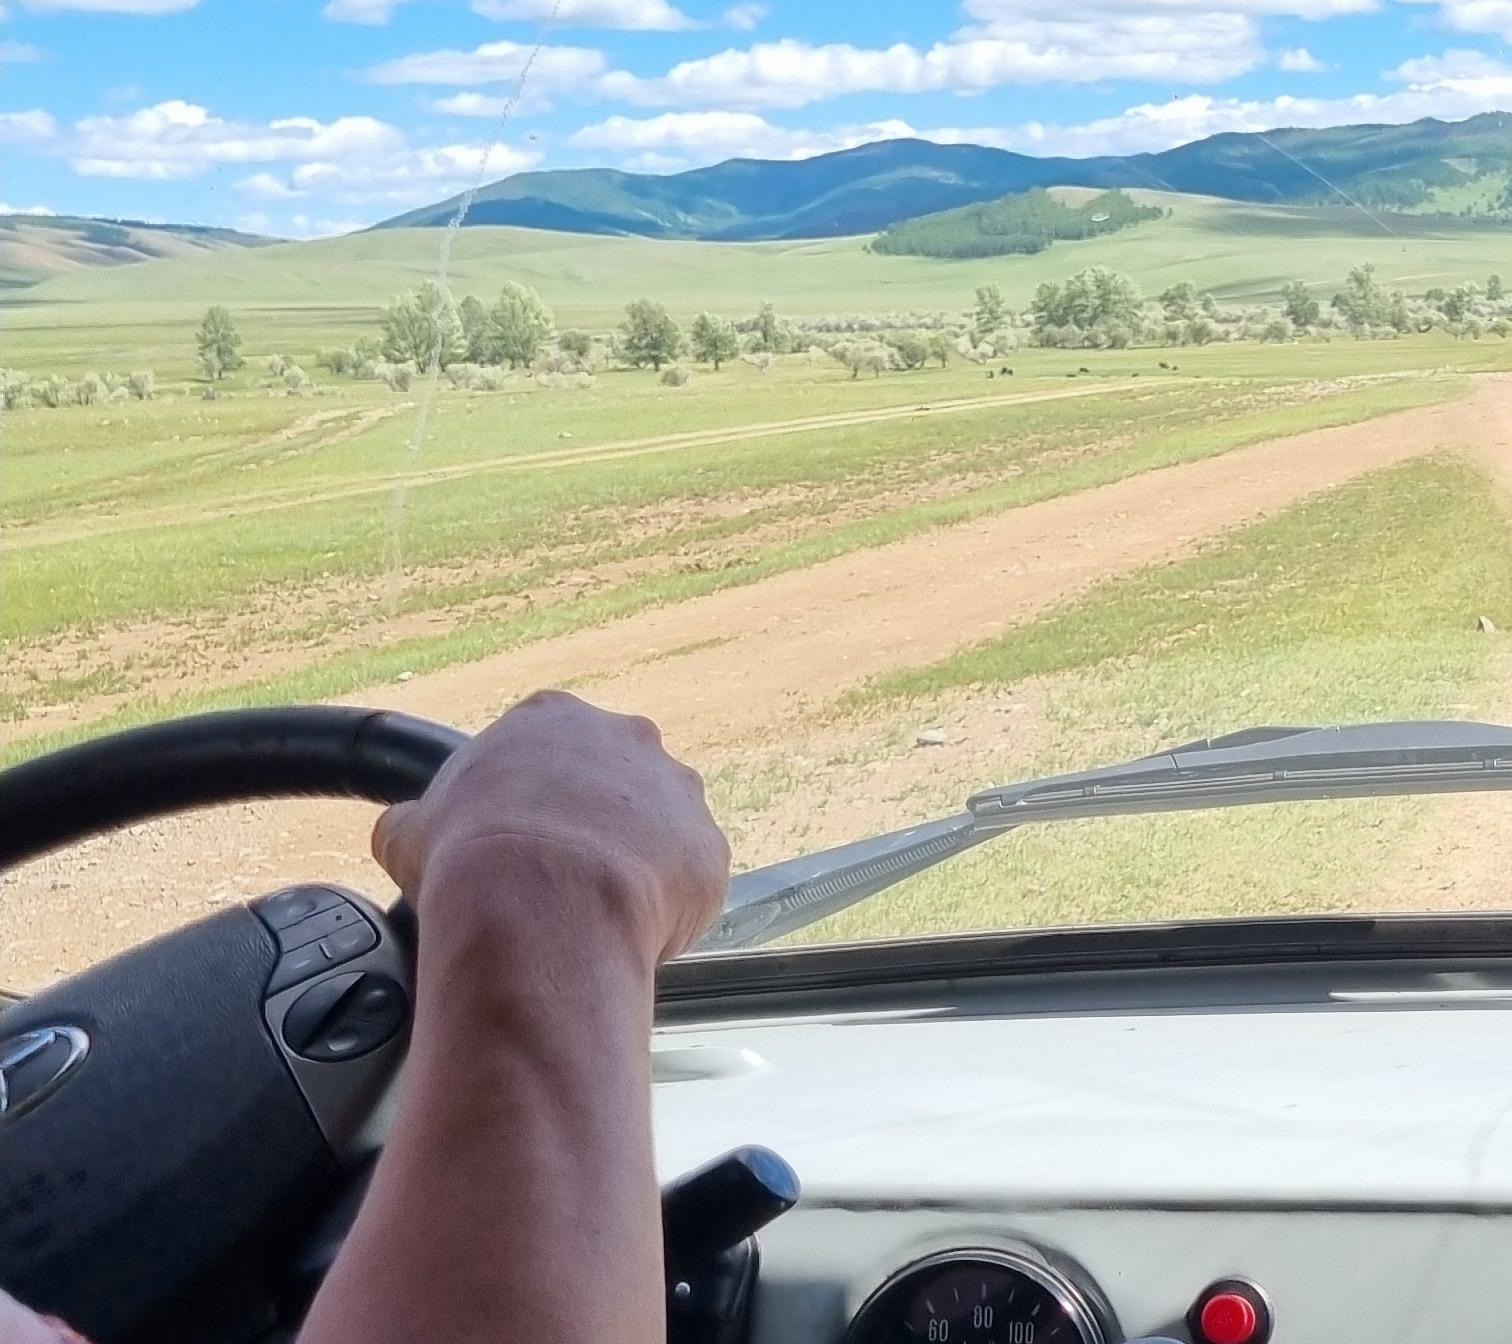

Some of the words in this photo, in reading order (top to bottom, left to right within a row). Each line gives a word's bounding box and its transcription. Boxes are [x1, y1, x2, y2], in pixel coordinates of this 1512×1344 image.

[973, 1305, 993, 1329] 80
[928, 1318, 949, 1343] 60
[1008, 1321, 1035, 1344] 100
